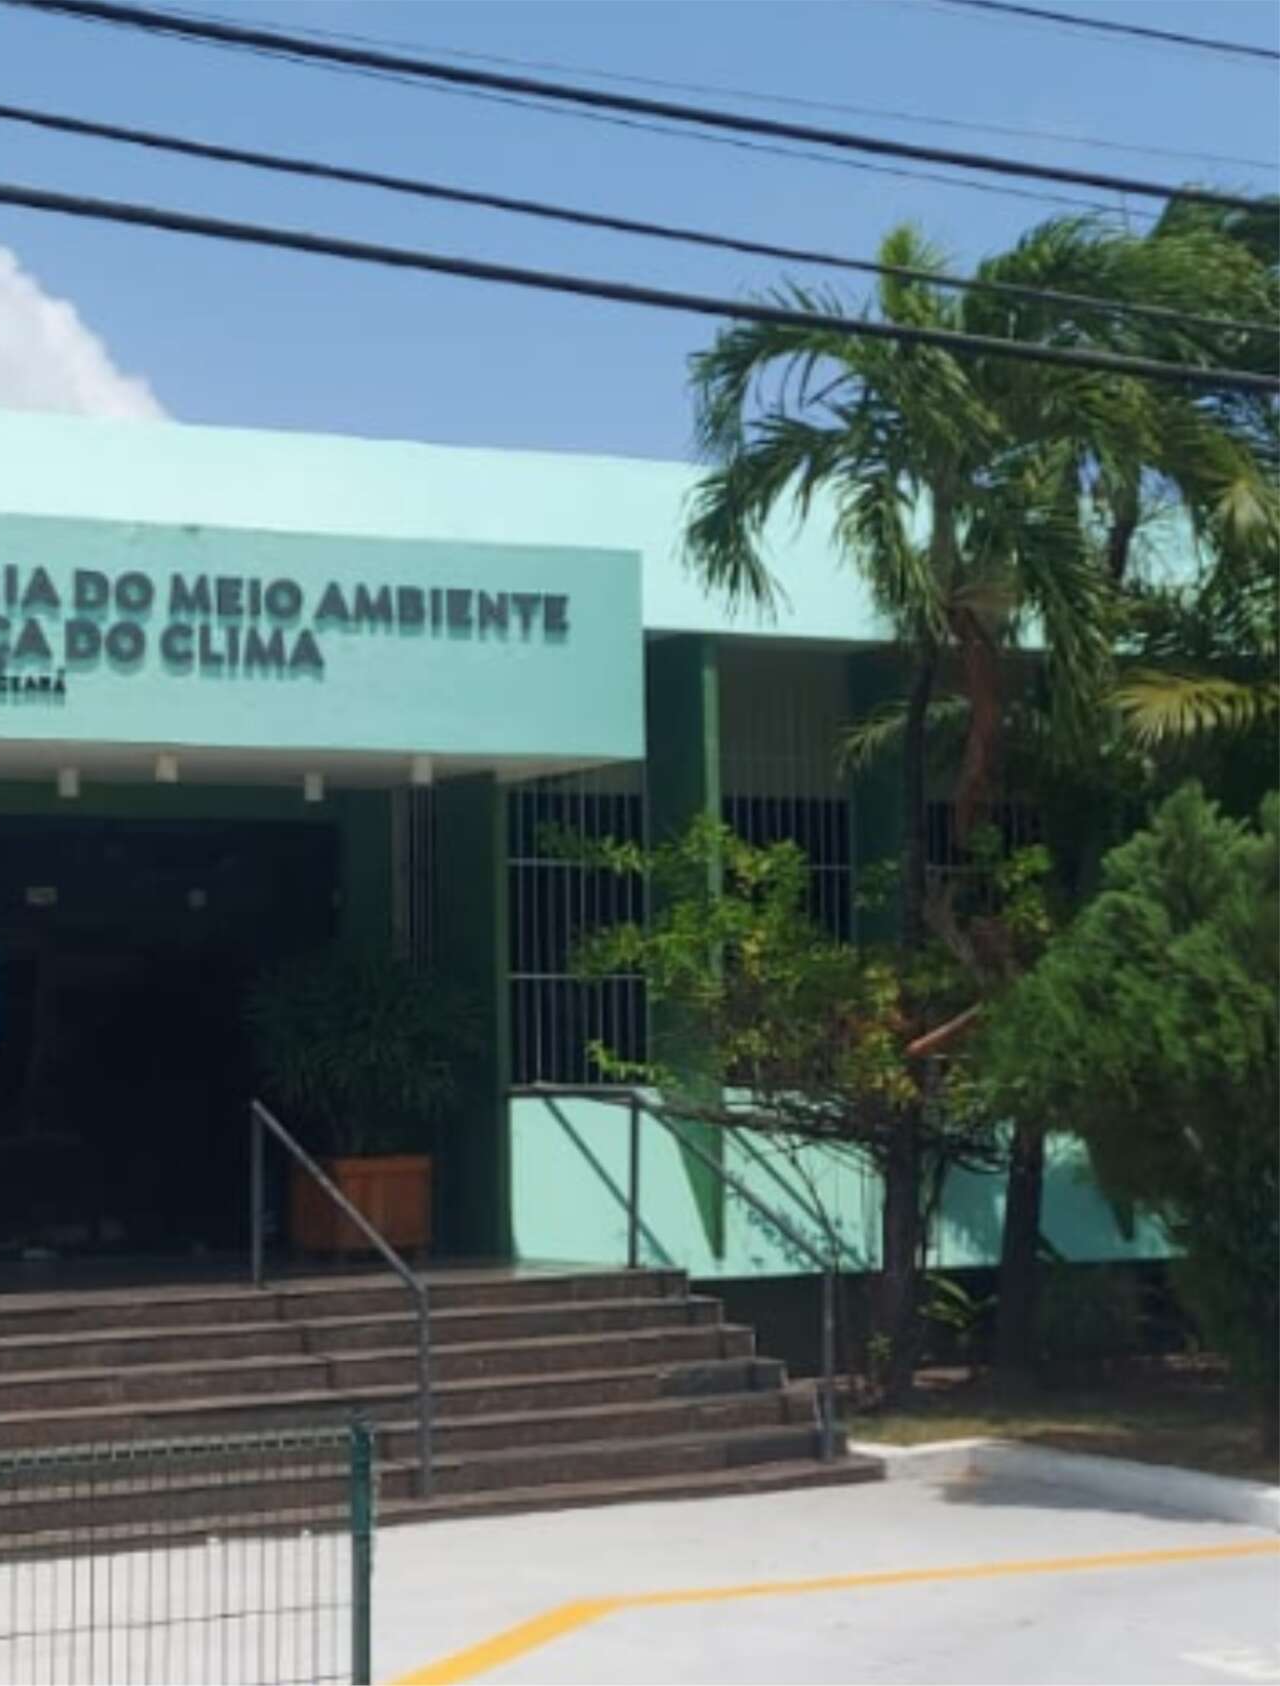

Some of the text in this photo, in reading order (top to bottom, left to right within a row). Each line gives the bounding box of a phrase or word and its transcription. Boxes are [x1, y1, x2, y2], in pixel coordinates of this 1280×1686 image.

[74, 569, 155, 617] DO
[170, 574, 303, 619] MEIO
[314, 581, 569, 633] AMBIENTE
[65, 619, 146, 663] DO
[159, 624, 325, 669] CLIMA
